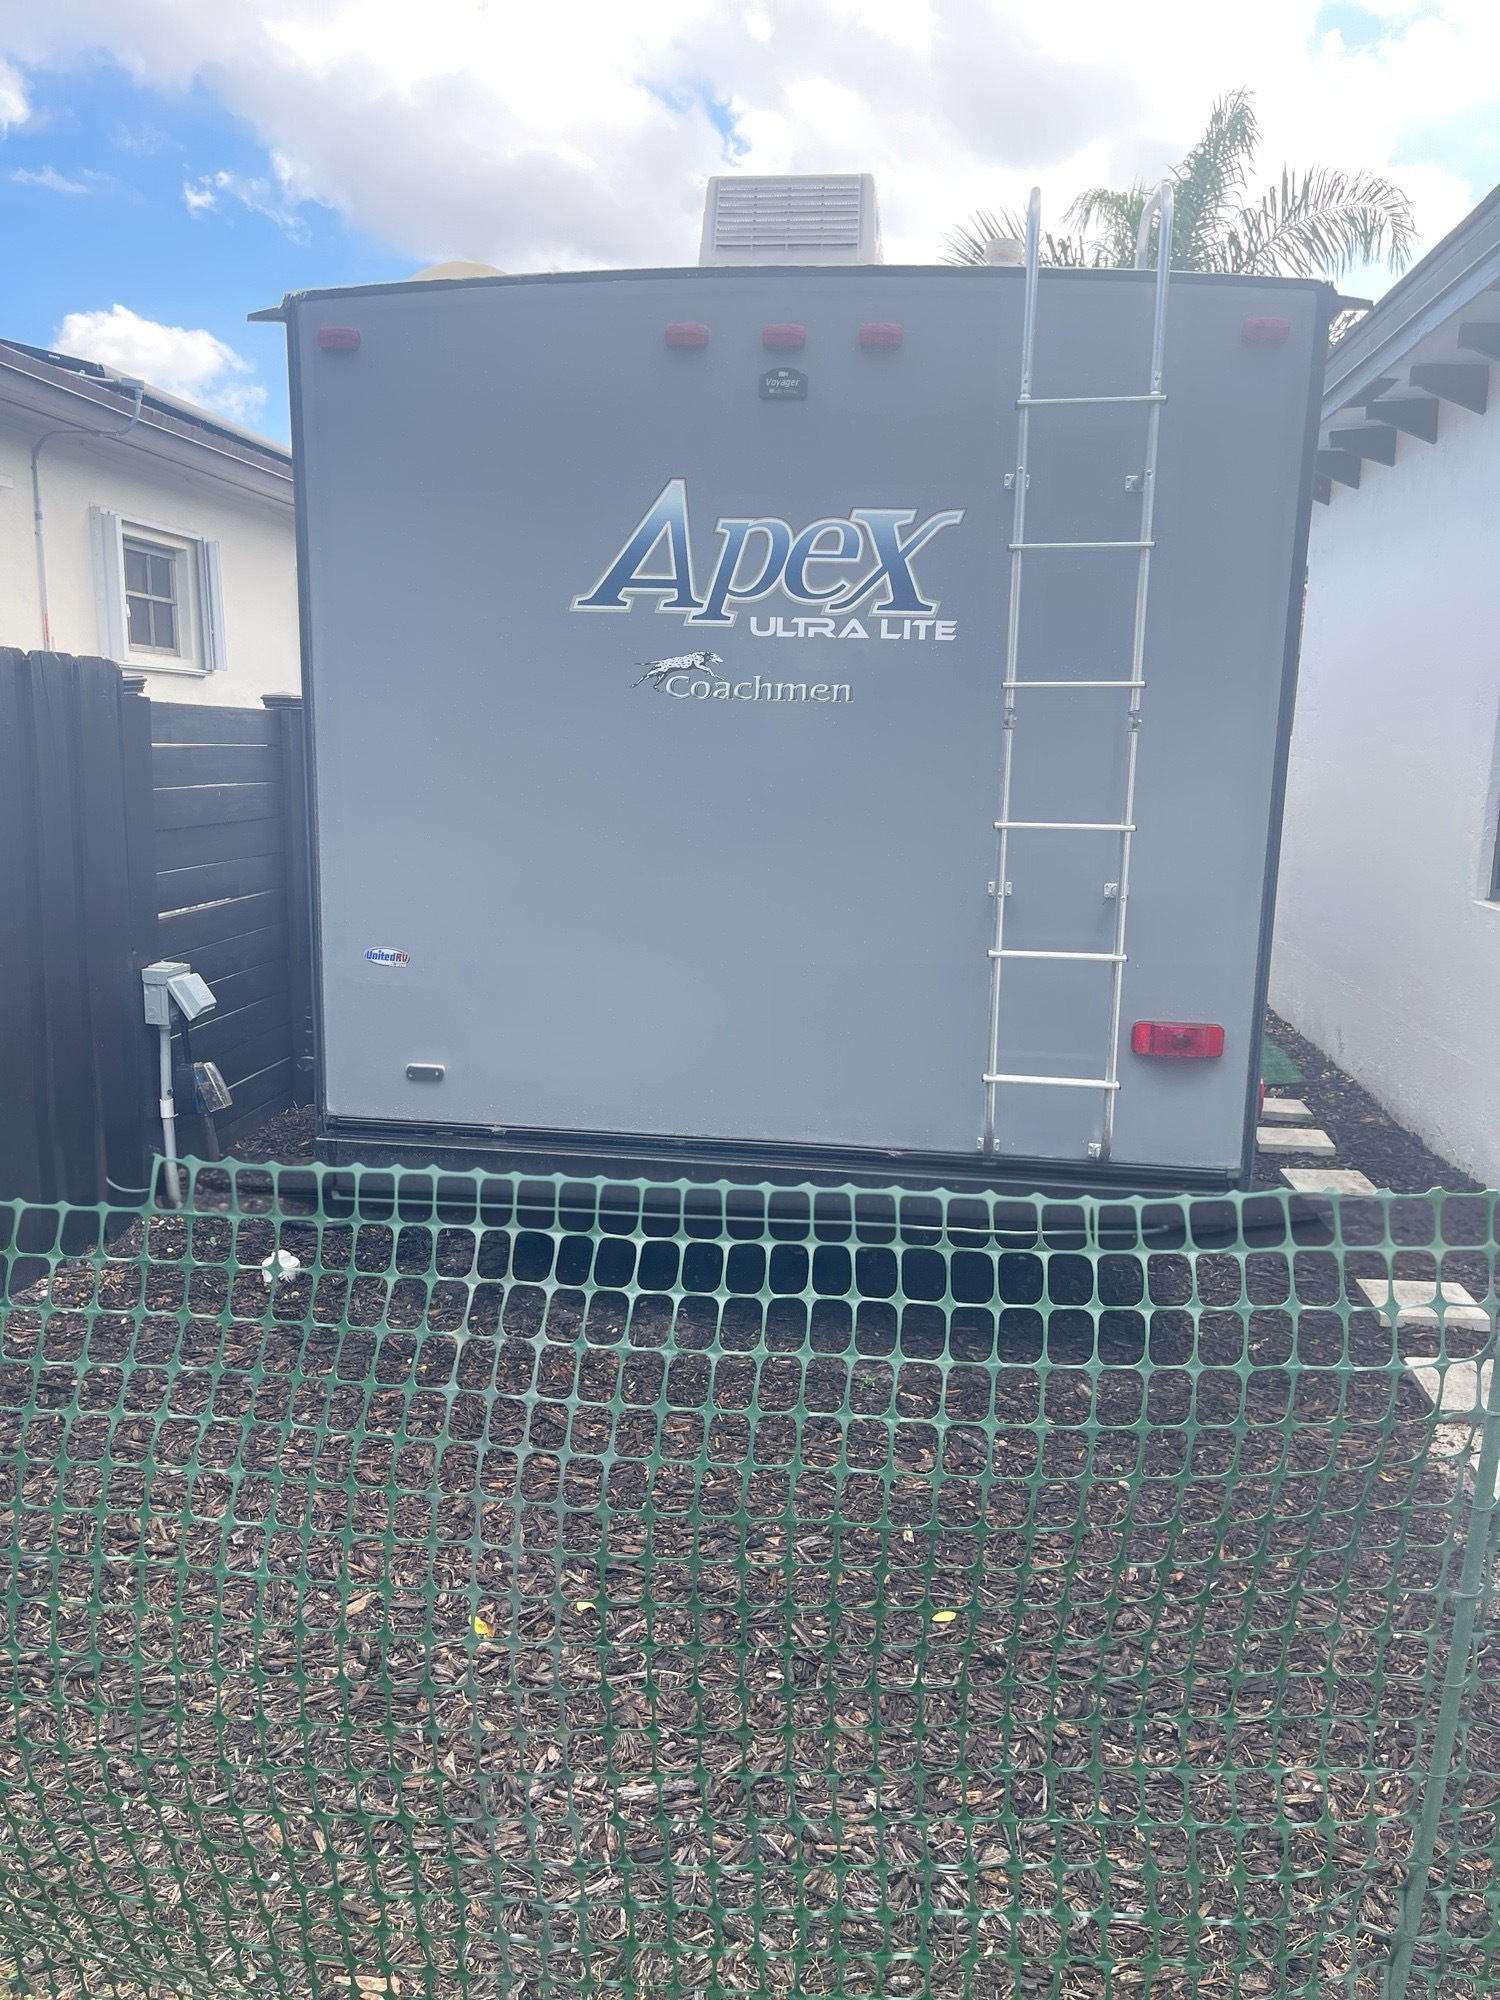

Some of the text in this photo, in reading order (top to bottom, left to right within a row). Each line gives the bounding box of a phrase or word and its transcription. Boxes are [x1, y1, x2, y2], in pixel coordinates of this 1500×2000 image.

[766, 378, 800, 388] Voyager
[569, 477, 967, 627] Apex
[750, 616, 958, 641] ULTRA LITE
[664, 674, 854, 703] Coachmen
[365, 950, 408, 963] UnitedRV
